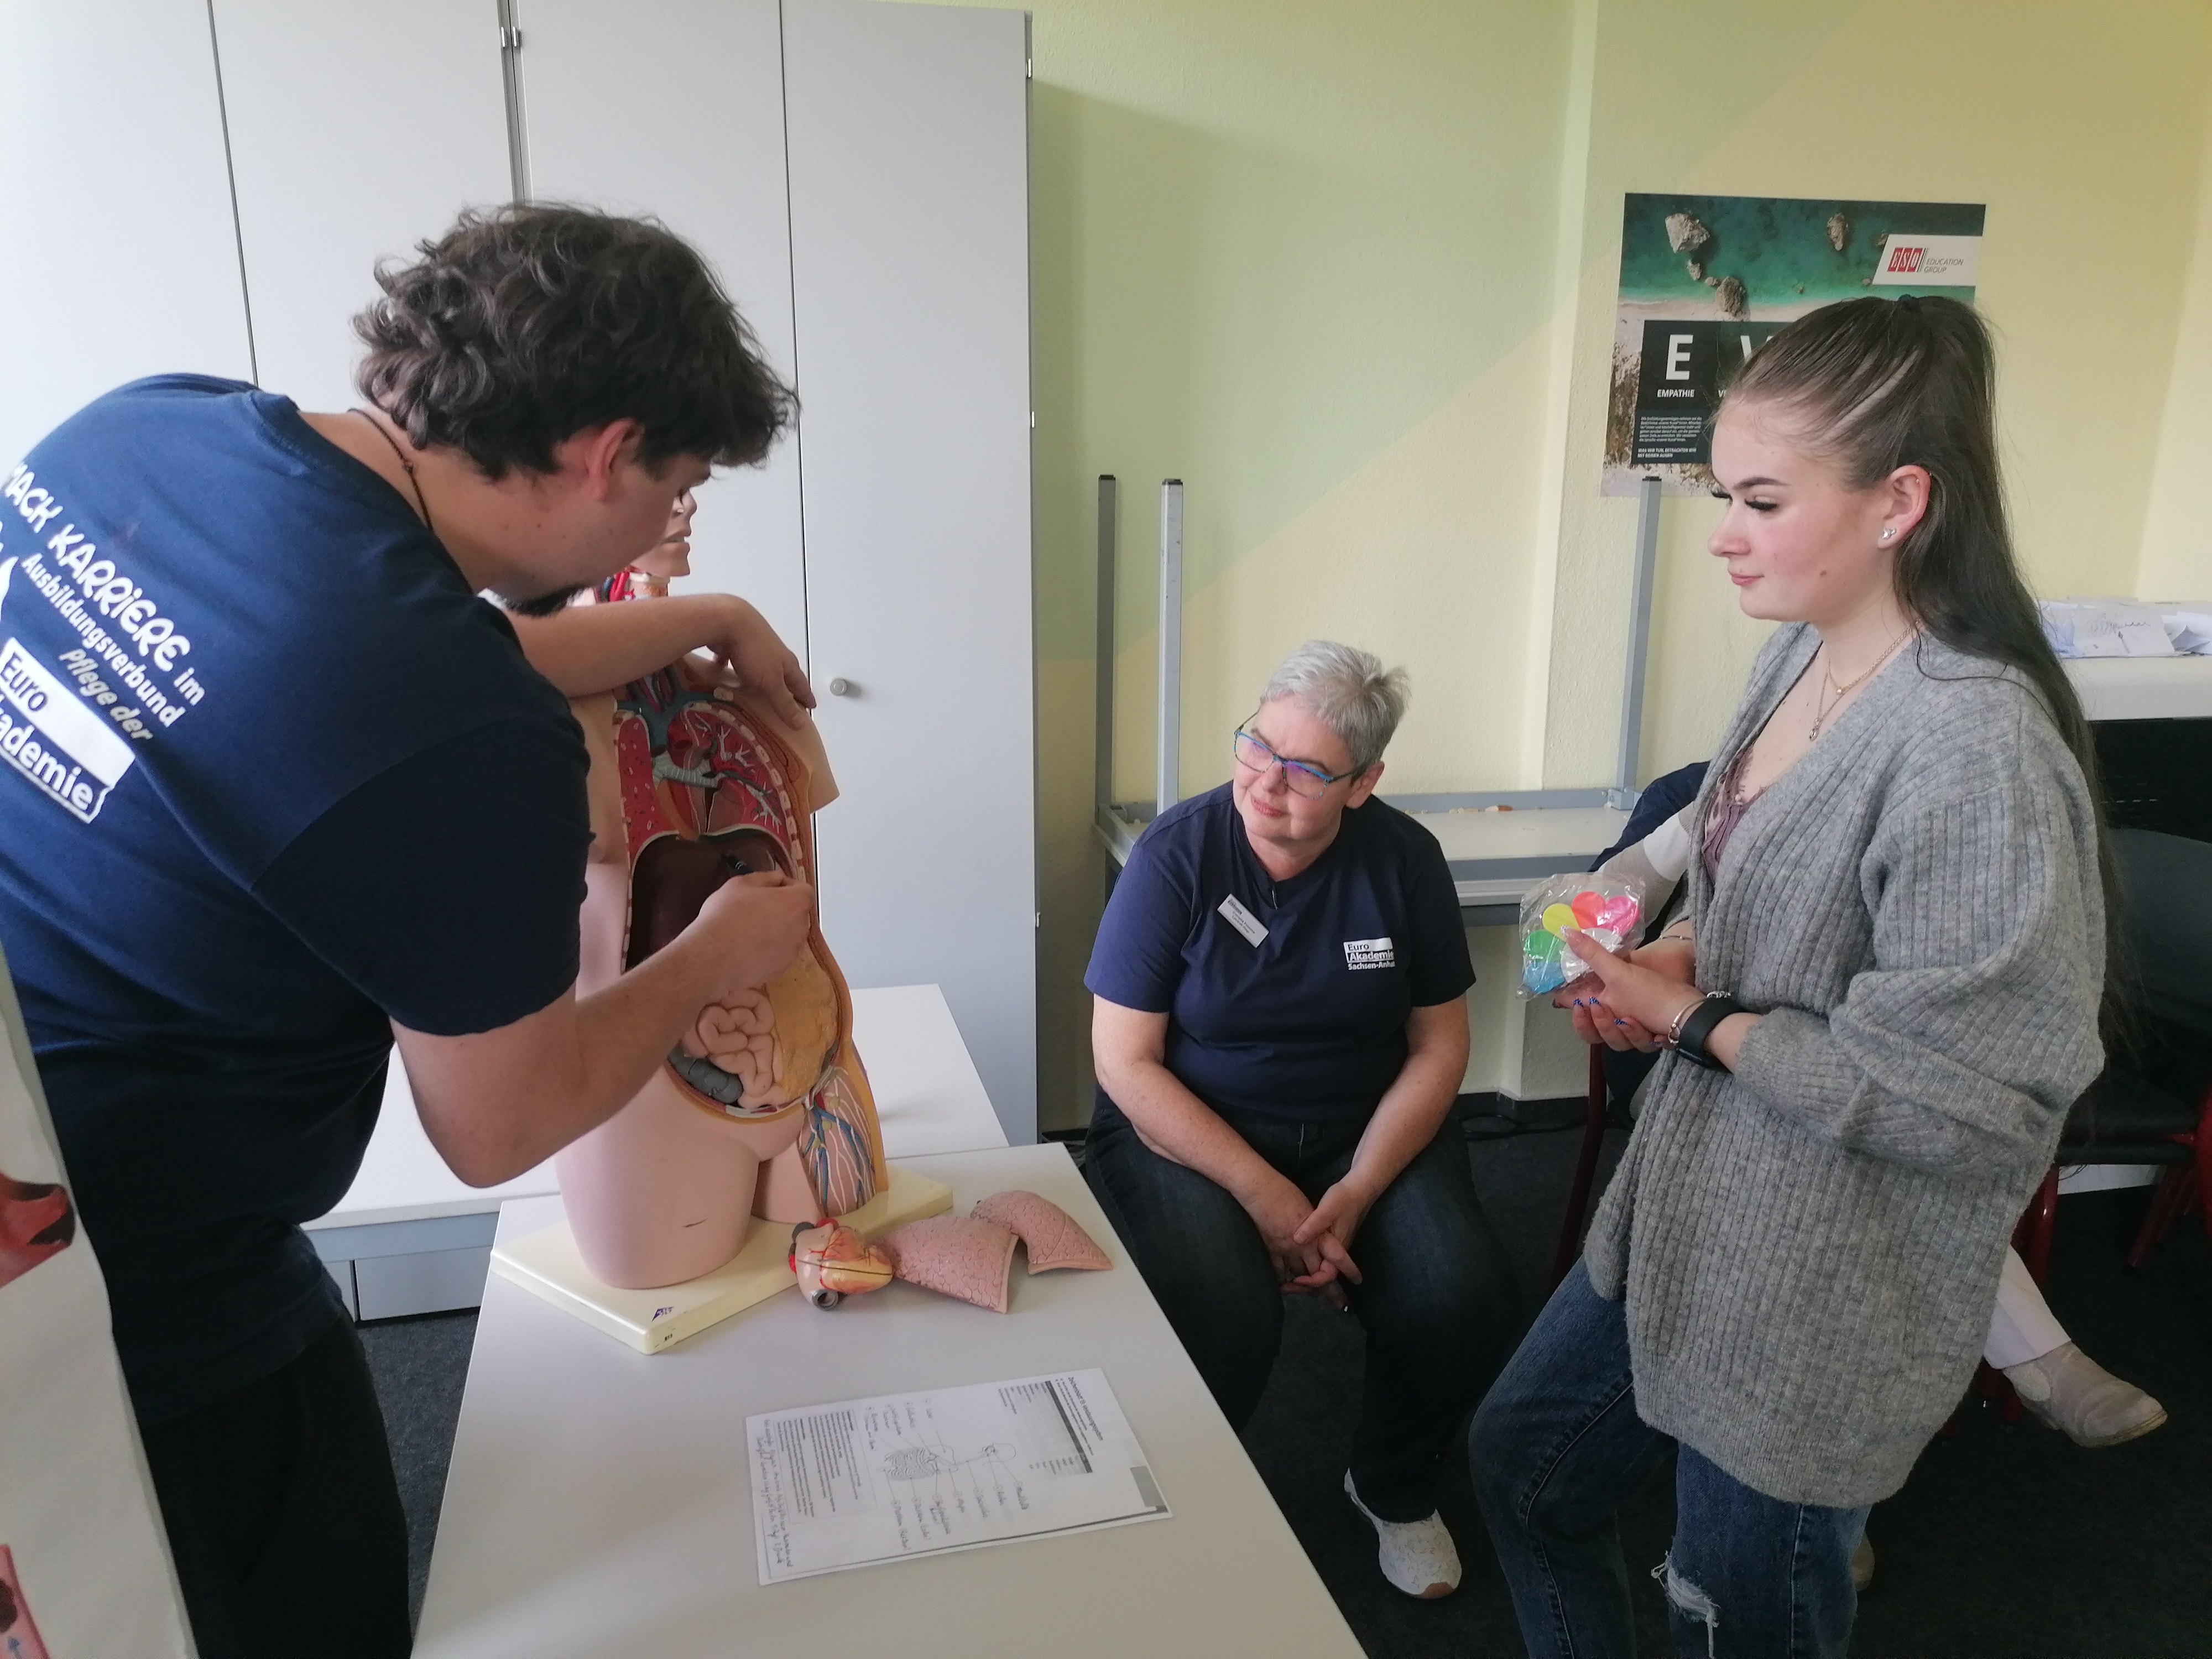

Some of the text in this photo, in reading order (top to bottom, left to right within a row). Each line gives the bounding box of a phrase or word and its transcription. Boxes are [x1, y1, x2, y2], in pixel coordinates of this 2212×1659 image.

[1889, 250, 1921, 269] ESO
[1666, 334, 1693, 380] E
[1657, 389, 1695, 398] EMPATHIE
[20, 553, 186, 728] Ausbildungsverbund
[1, 651, 48, 712] Euro
[59, 649, 154, 740] Pflege der
[173, 667, 205, 706] im
[0, 695, 93, 811] ademie
[1350, 950, 1394, 961] Akademie
